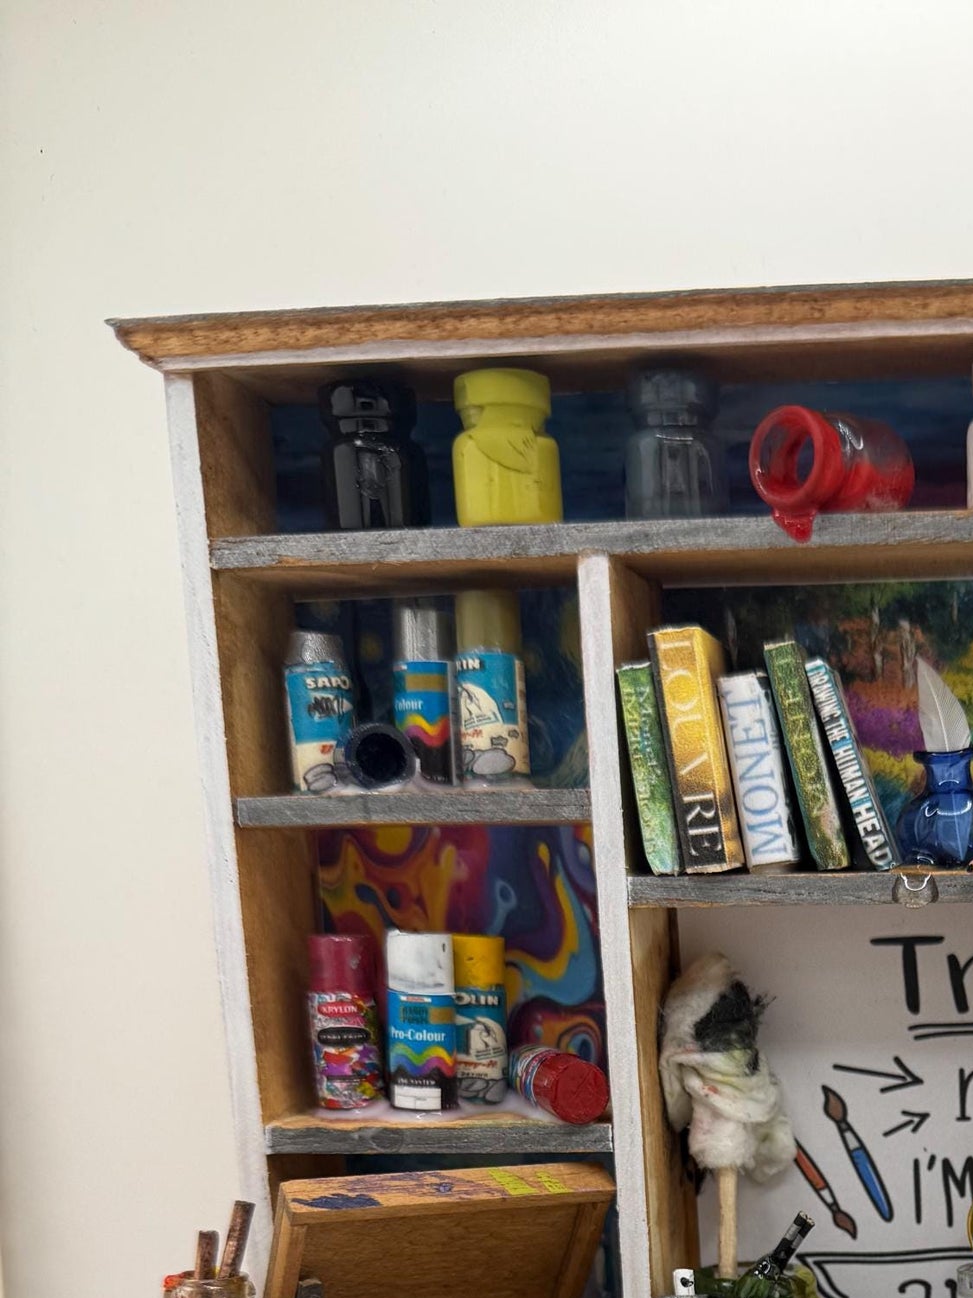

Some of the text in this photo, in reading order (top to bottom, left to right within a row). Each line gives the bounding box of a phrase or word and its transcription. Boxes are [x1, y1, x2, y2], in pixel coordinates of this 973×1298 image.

[657, 640, 723, 857] LOUVRE
[724, 689, 788, 859] MONET
[811, 670, 892, 868] DRAWING THE HUMAN HEAD
[391, 1026, 446, 1042] Pro-Colour
